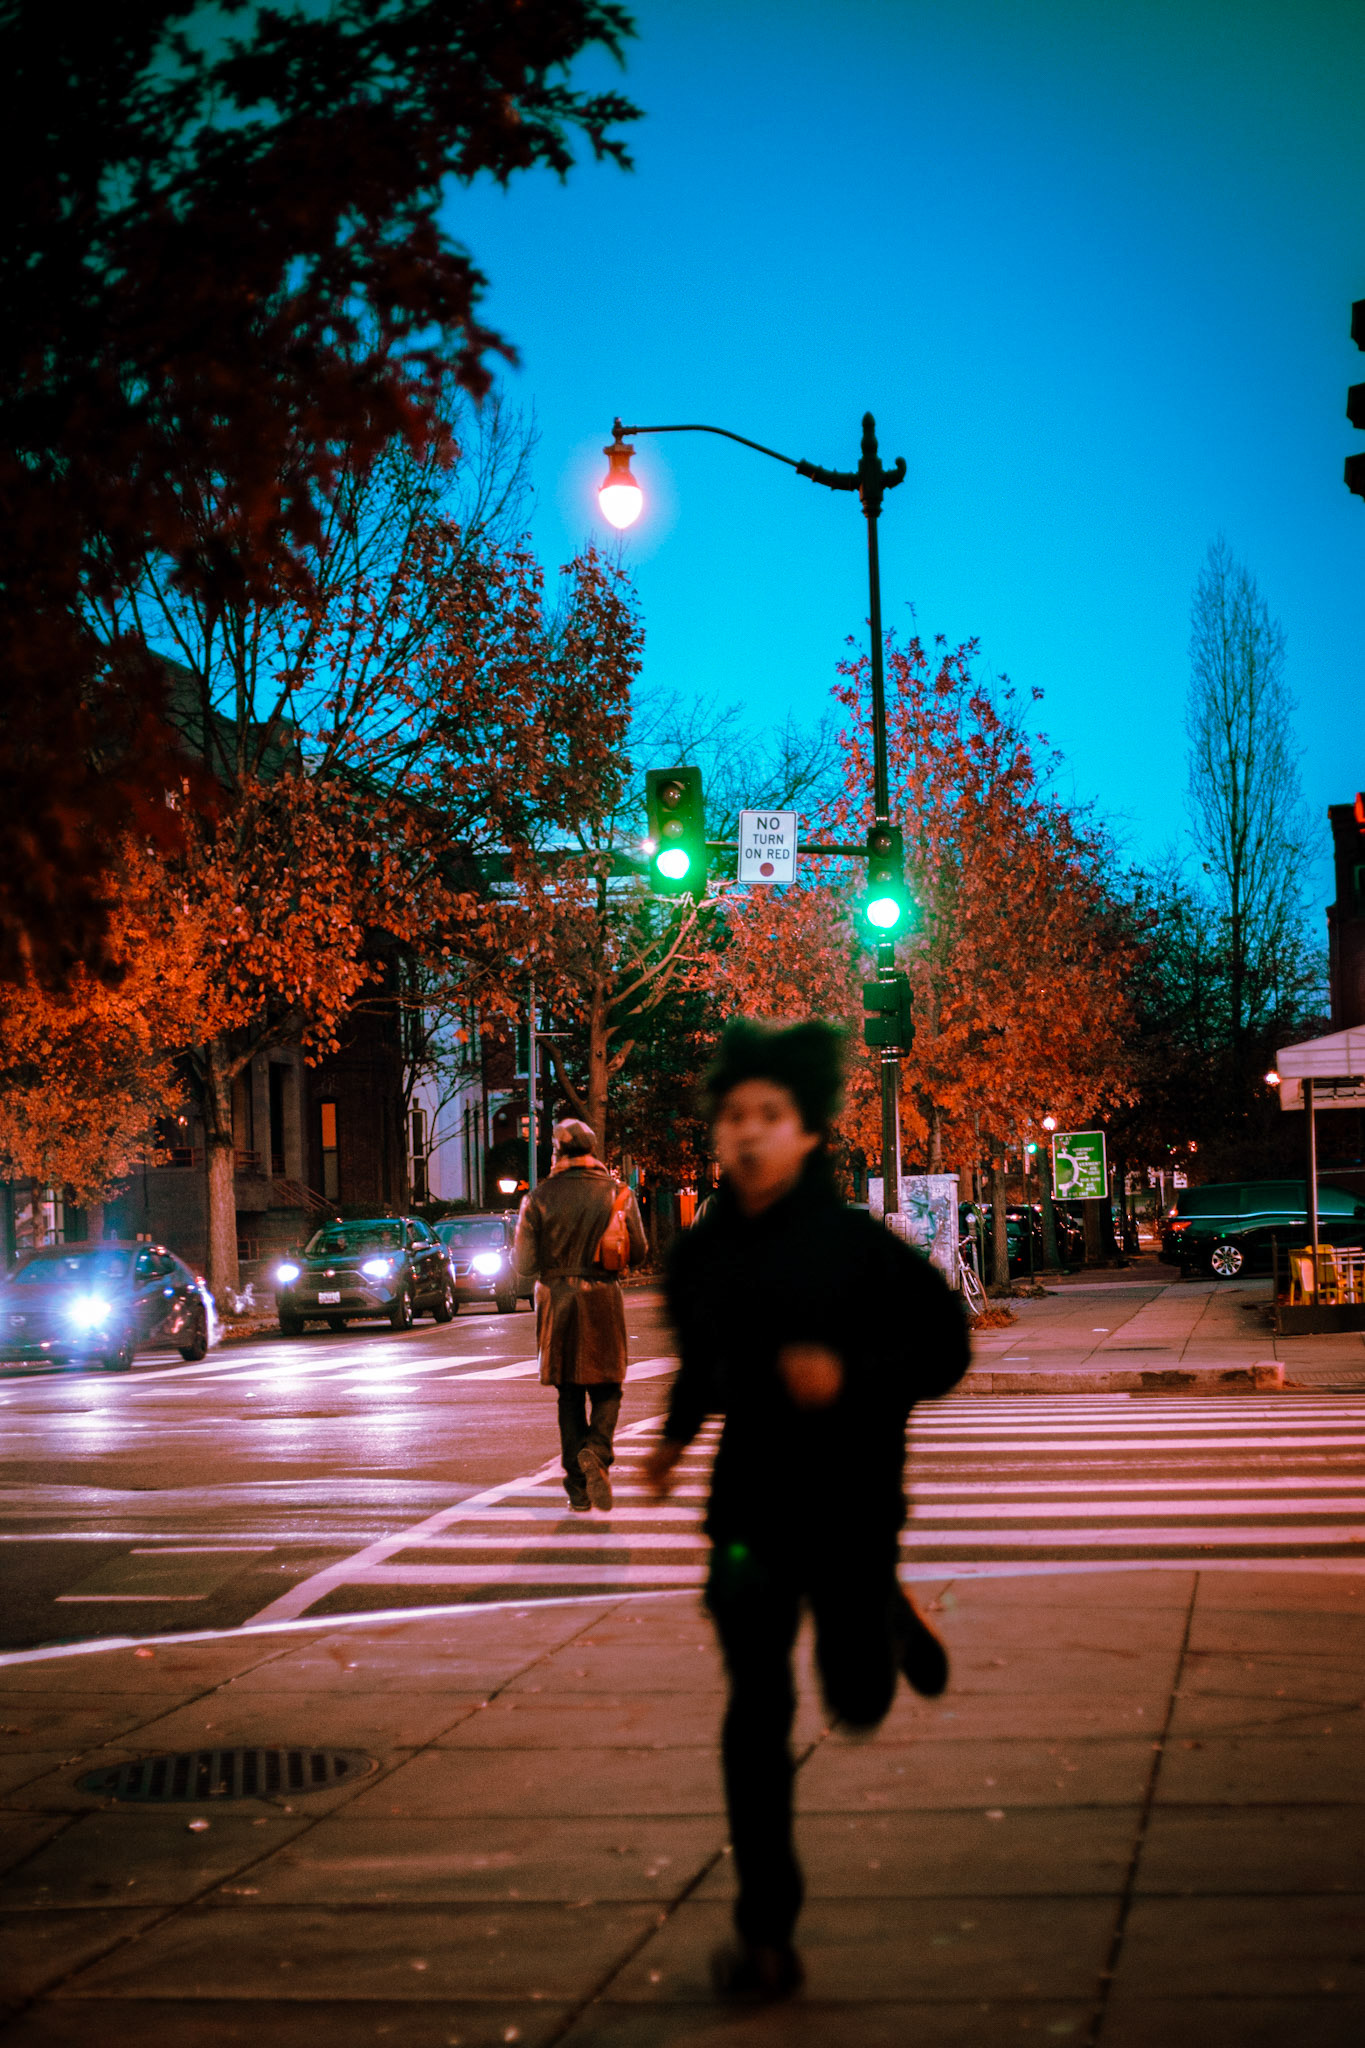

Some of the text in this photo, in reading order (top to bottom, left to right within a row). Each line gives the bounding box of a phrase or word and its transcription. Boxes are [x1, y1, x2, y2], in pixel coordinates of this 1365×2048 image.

[757, 817, 780, 830] NO
[753, 834, 784, 844] TURN
[745, 848, 790, 859] ON RED
